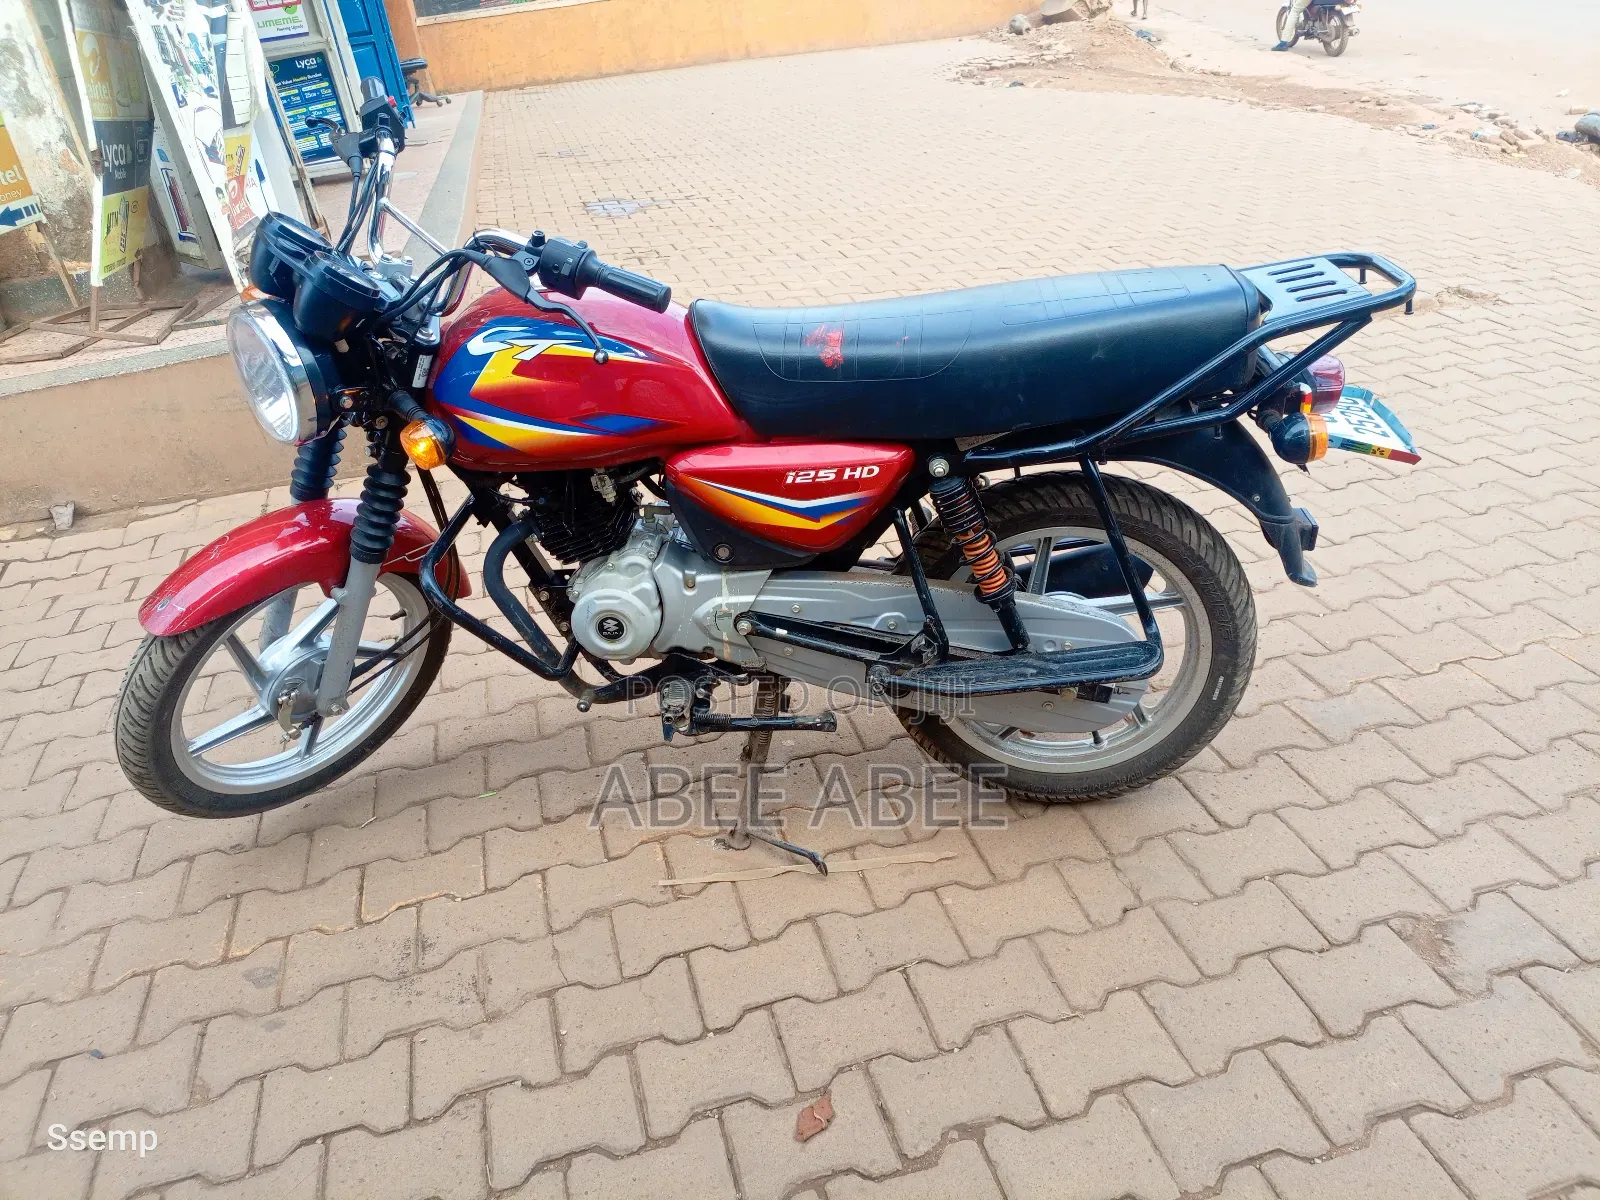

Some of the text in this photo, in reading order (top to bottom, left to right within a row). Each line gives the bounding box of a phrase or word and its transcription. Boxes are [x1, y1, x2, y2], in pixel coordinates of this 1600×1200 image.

[257, 16, 302, 28] UMEME
[295, 57, 318, 69] Lyca
[100, 139, 126, 173] Lyca
[466, 326, 583, 361] CT
[842, 465, 880, 480] HD
